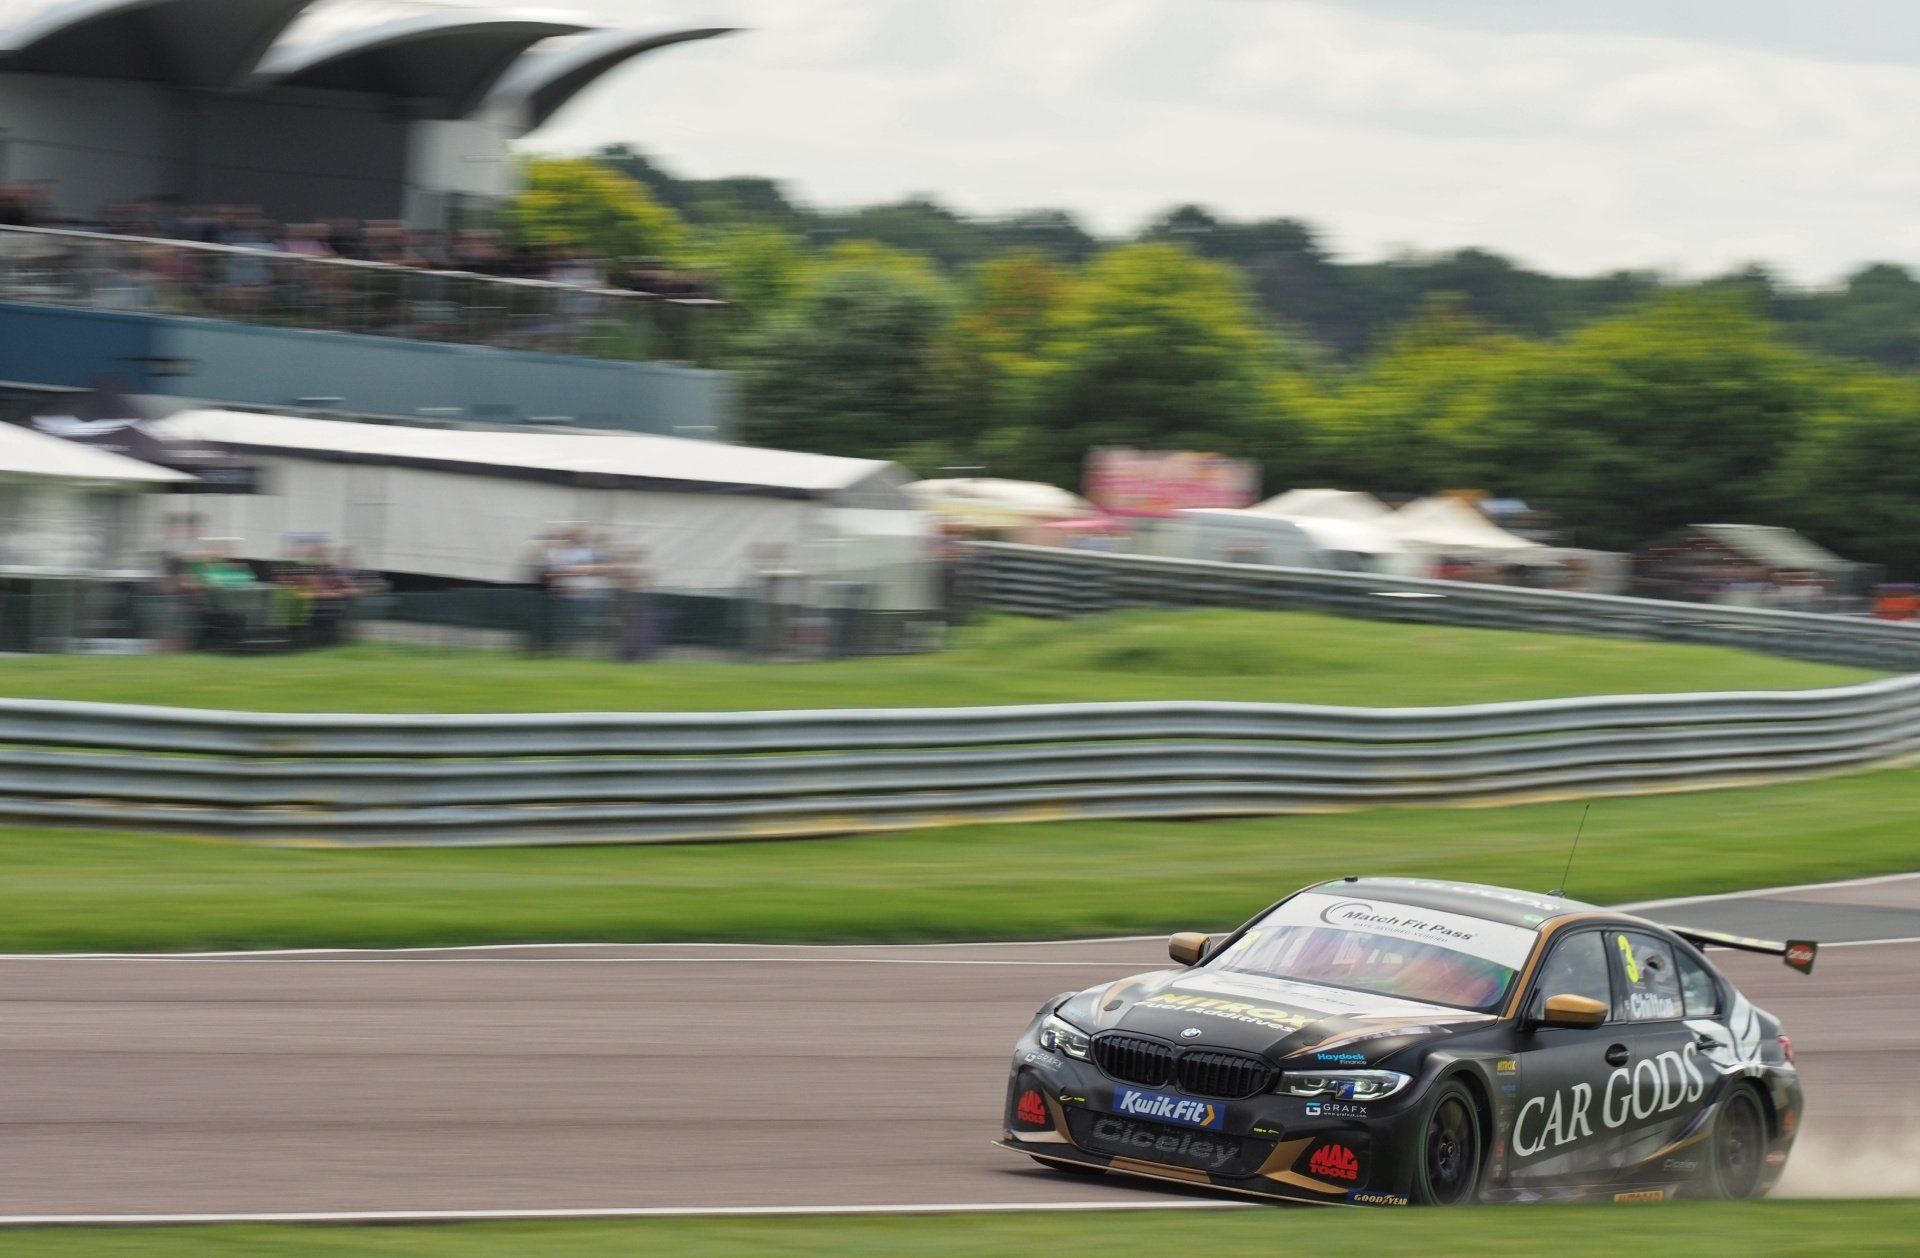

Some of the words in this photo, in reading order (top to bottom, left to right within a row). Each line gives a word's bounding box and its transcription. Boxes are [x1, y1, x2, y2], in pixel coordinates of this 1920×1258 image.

[1343, 911, 1400, 925] Match
[1402, 919, 1428, 930] Fit
[1429, 924, 1473, 941] Pass
[1618, 935, 1639, 983] 3
[1134, 1001, 1184, 1010] Fuel
[1186, 1006, 1298, 1033] Additives
[1317, 1053, 1366, 1061] Haydock
[1323, 1103, 1367, 1114] GRAFX
[1512, 1082, 1594, 1157] CAR
[1602, 1041, 1705, 1128] GODS
[1093, 1118, 1240, 1168] Ciceley
[1309, 1144, 1358, 1171] MAC
[1309, 1163, 1358, 1180] TOOLS
